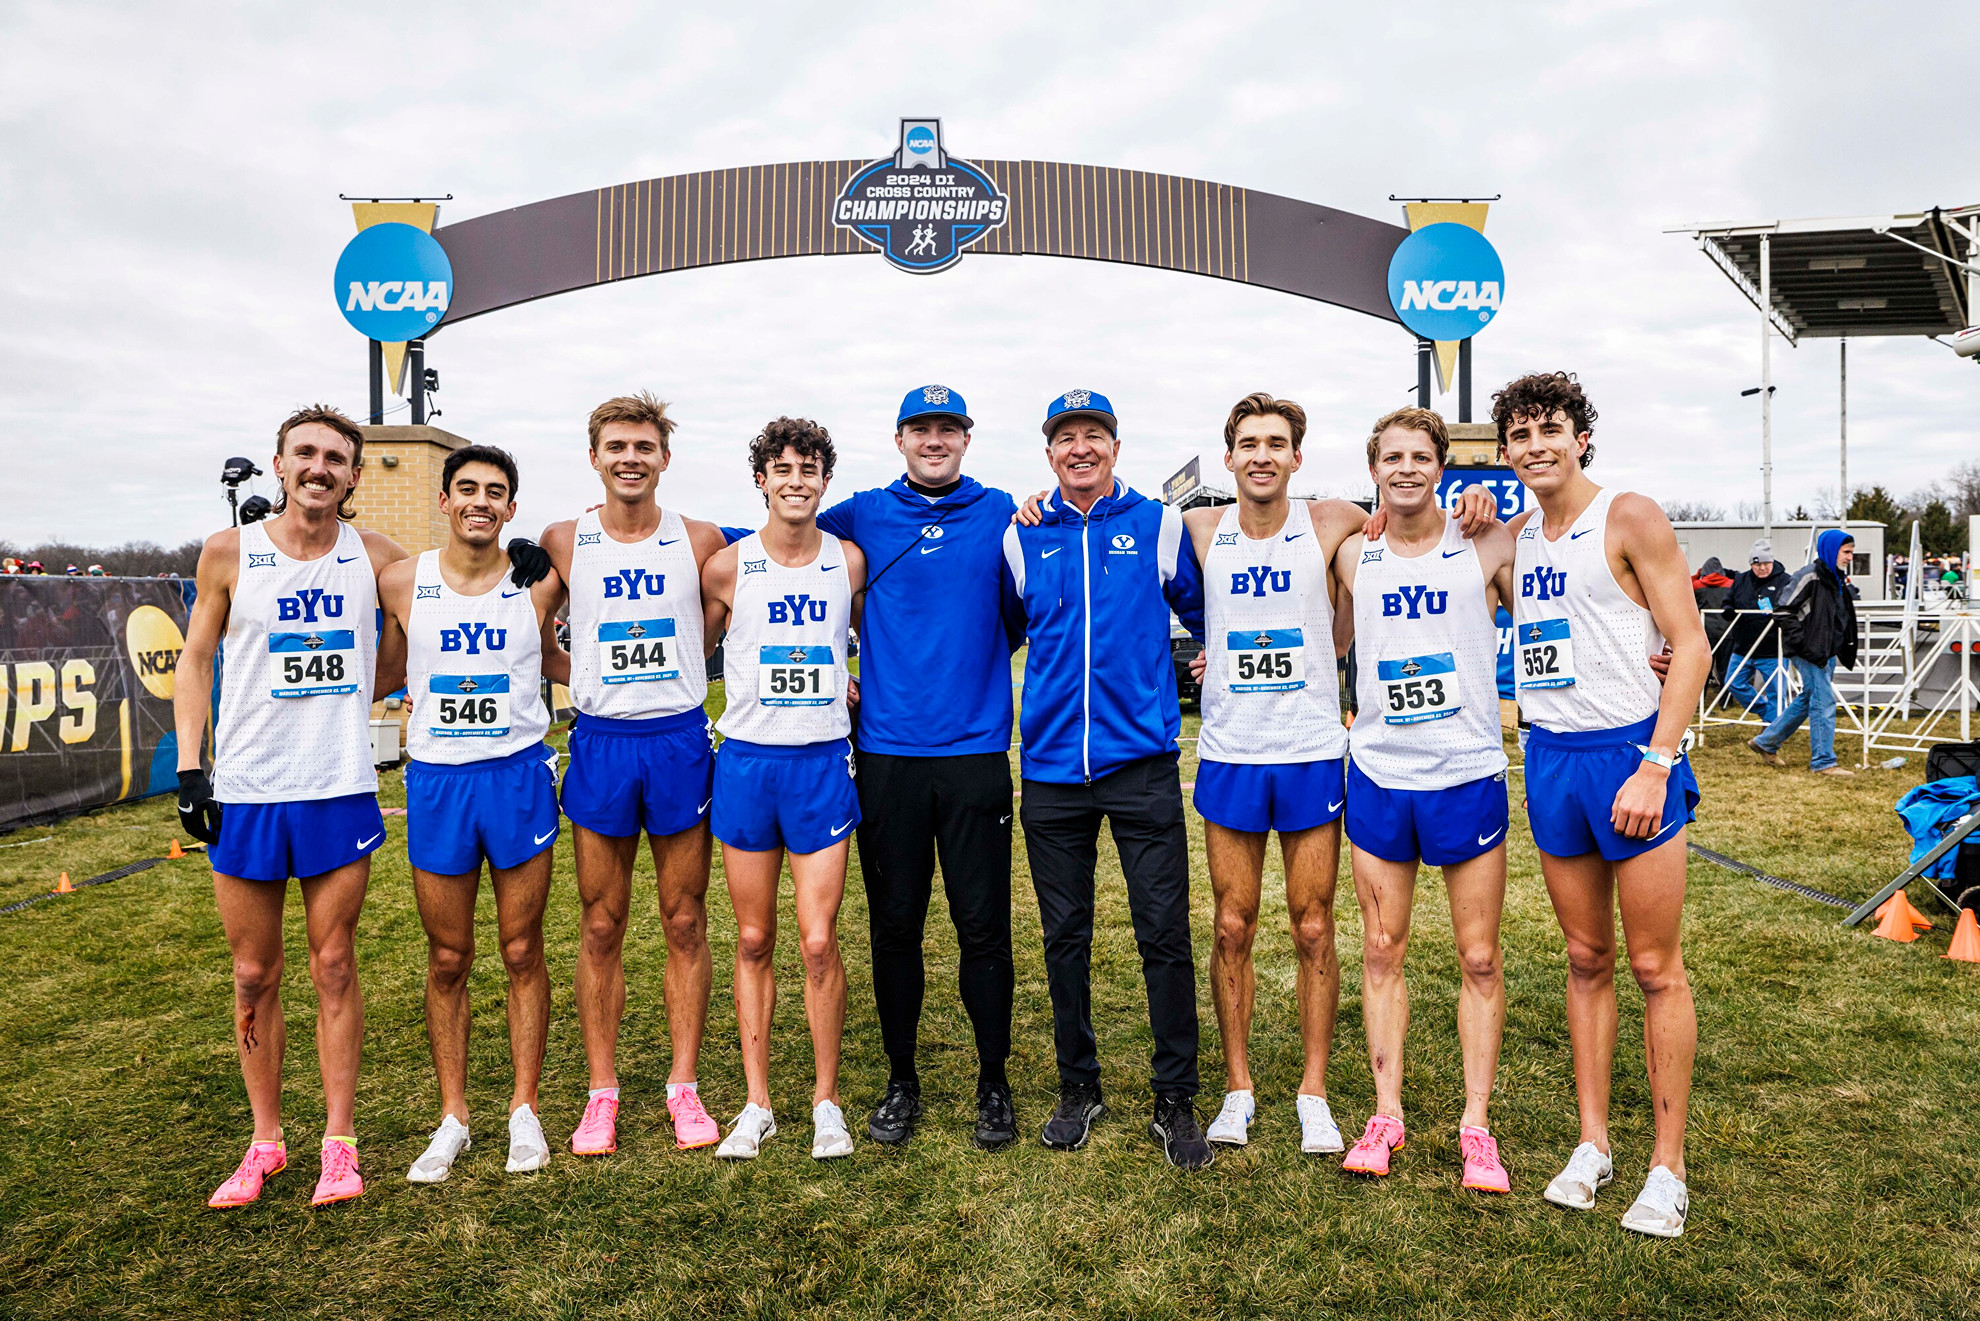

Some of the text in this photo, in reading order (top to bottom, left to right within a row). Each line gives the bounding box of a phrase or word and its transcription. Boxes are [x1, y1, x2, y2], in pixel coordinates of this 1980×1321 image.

[909, 140, 935, 148] NCAA
[866, 186, 976, 198] CROSS COUNTRY
[886, 174, 955, 185] 2024 DI
[838, 200, 1003, 220] CHAMPIONSHIPS
[345, 281, 449, 311] NCAA
[1400, 280, 1500, 310] NCAA
[603, 568, 665, 600] BYU
[1231, 565, 1291, 597] BYU
[1521, 565, 1567, 600] BYU
[277, 588, 344, 623] BYU
[767, 594, 827, 626] BYU
[1382, 585, 1448, 619] BYU
[440, 622, 507, 655] BYU
[284, 654, 345, 683] 548
[611, 642, 666, 670] 544
[1238, 652, 1292, 679] 545
[1523, 645, 1559, 677] 552
[770, 668, 819, 693] 551
[1388, 679, 1445, 712] 553
[440, 698, 497, 724] 546
